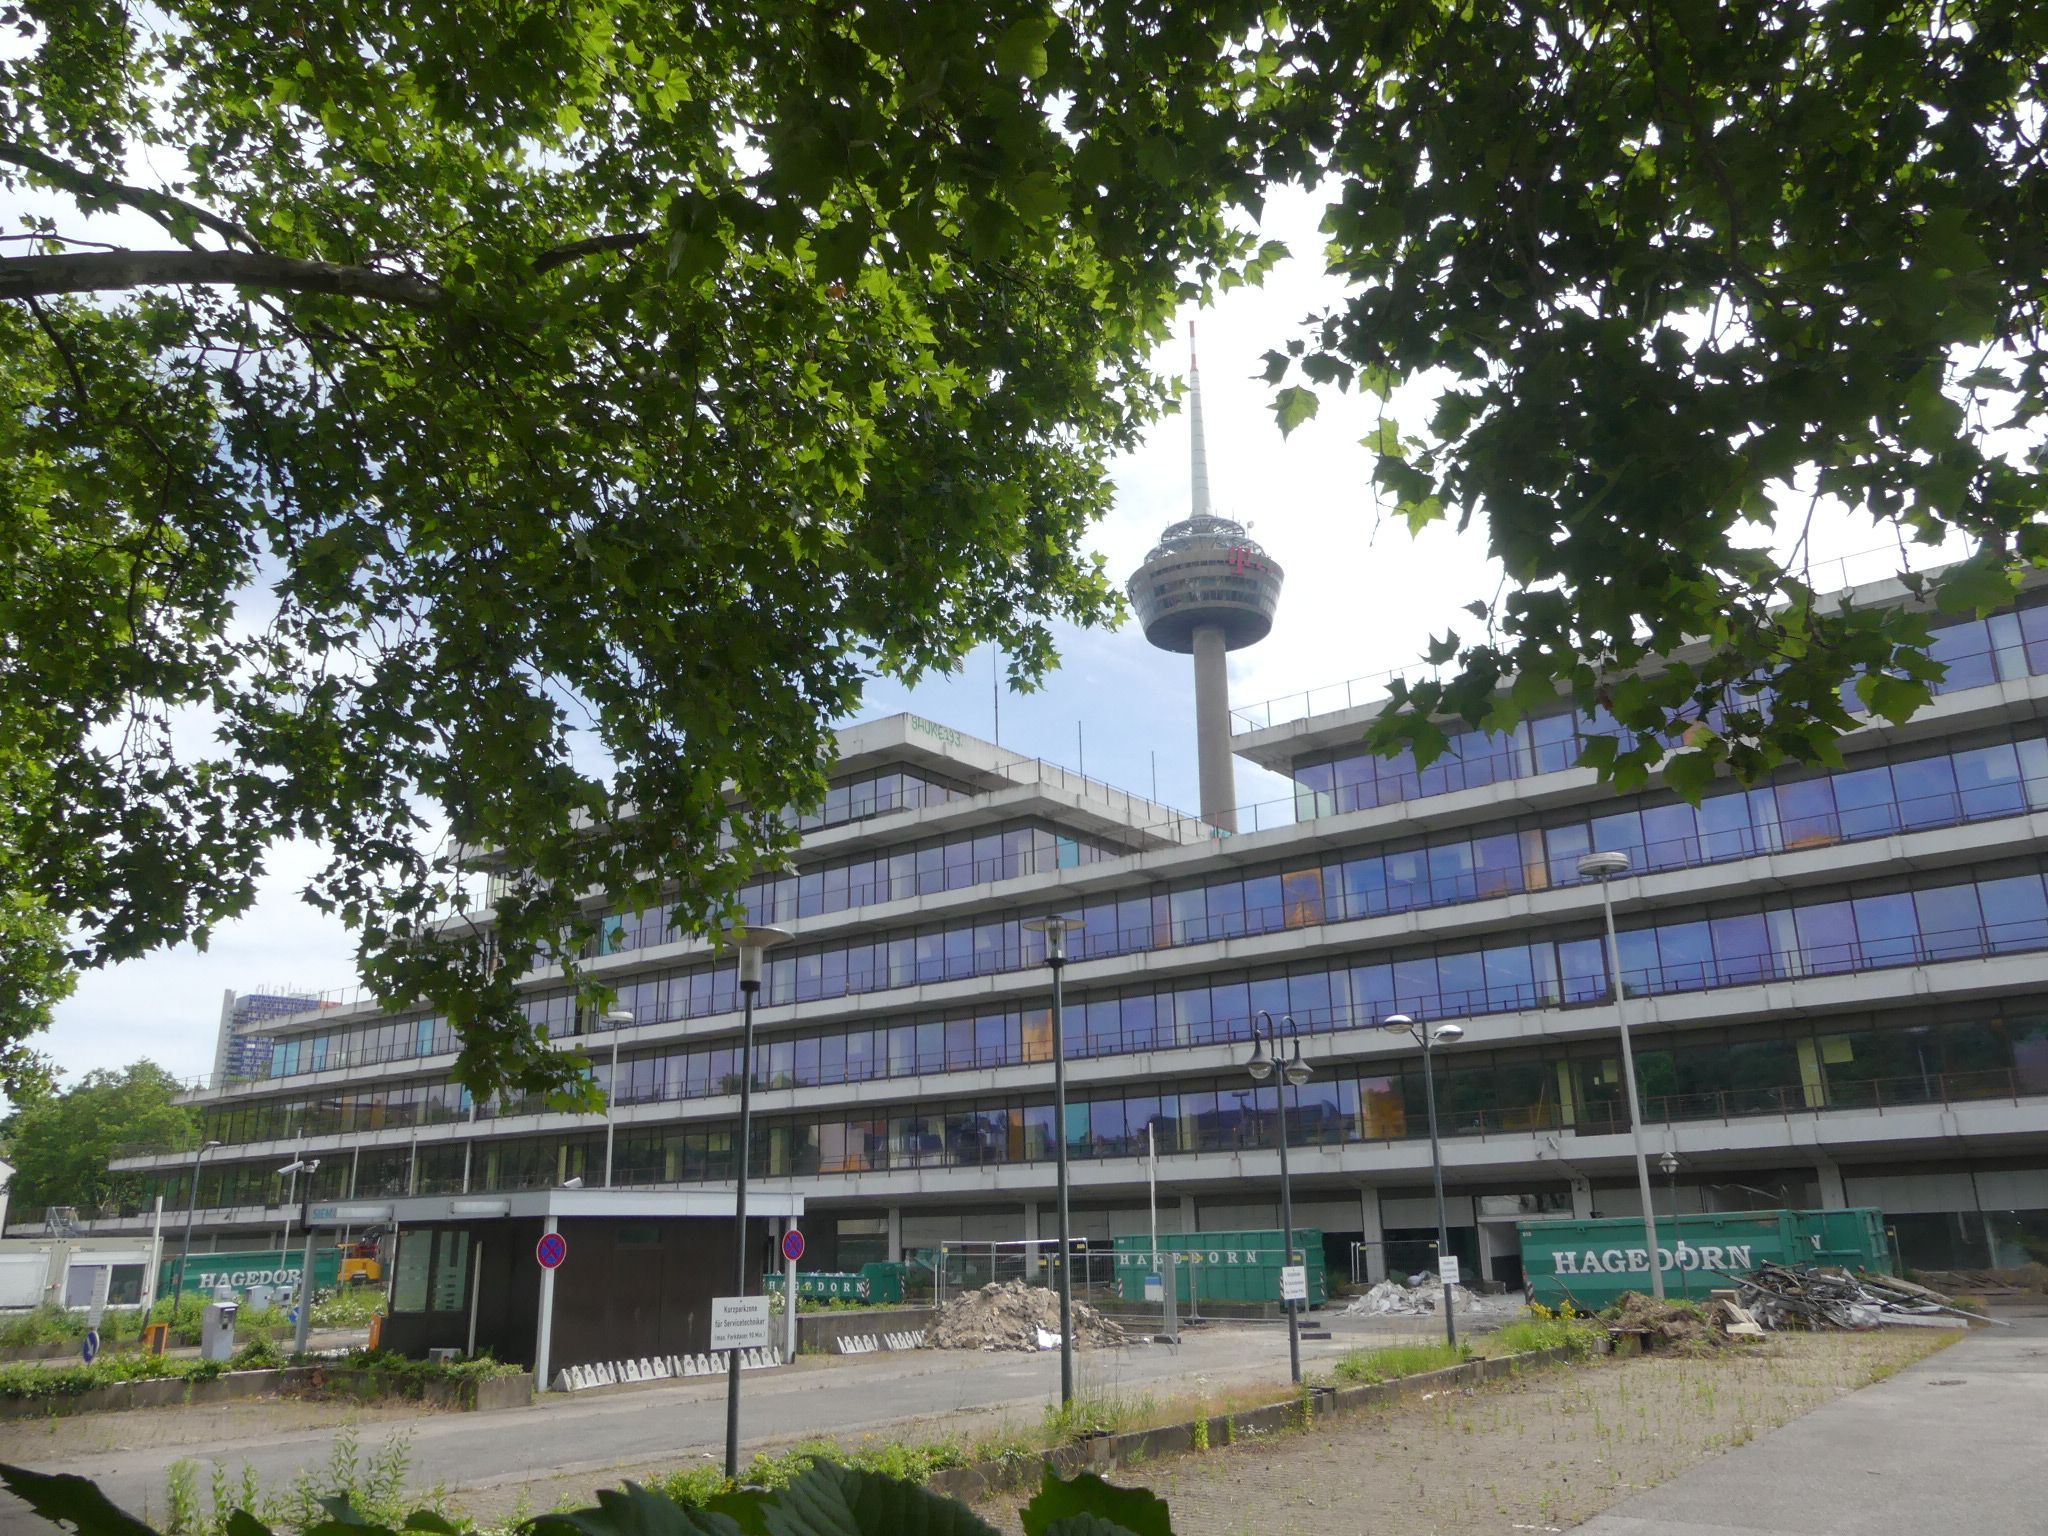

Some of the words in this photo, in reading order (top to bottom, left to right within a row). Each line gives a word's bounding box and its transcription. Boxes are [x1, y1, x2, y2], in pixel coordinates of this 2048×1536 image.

[1119, 1250, 1257, 1265] HAGEDORN
[1552, 1245, 1752, 1274] HAGEDORN
[198, 1269, 304, 1289] HAGEDOR
